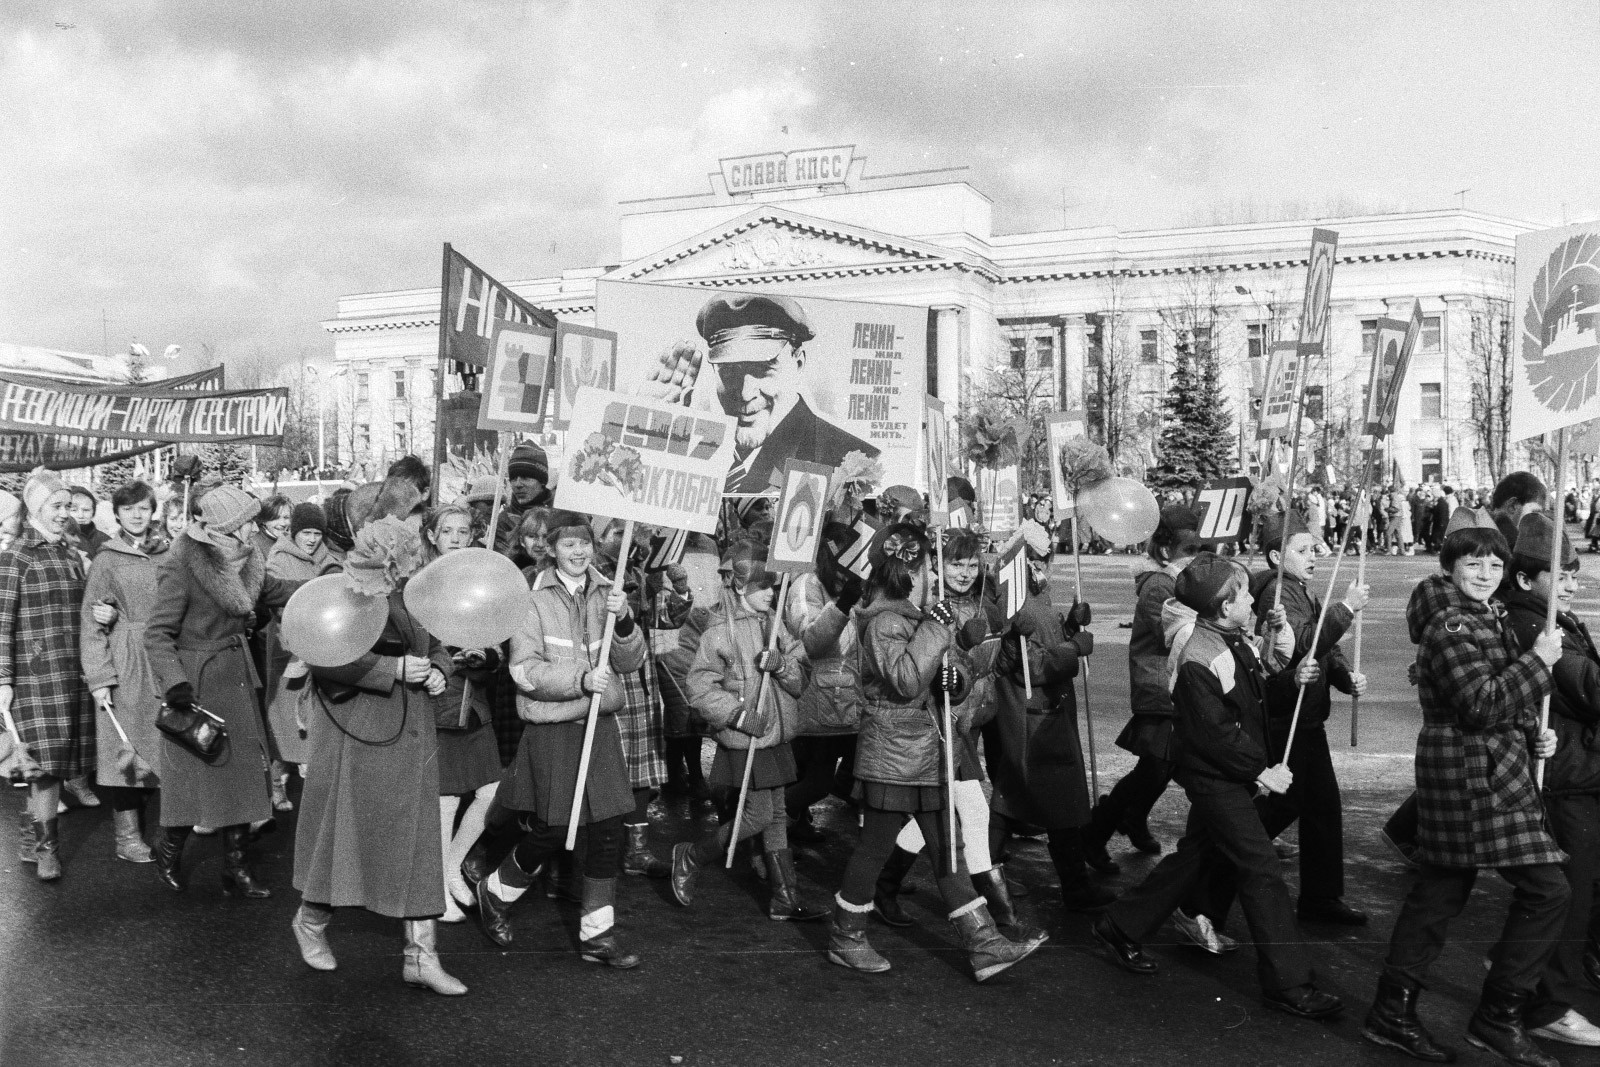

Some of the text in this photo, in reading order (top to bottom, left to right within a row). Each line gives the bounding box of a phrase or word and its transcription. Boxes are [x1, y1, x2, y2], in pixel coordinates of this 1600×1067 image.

[731, 155, 842, 187] СЛАВА КПСС
[870, 421, 909, 431] БУДЕТ
[1197, 486, 1248, 539] 70
